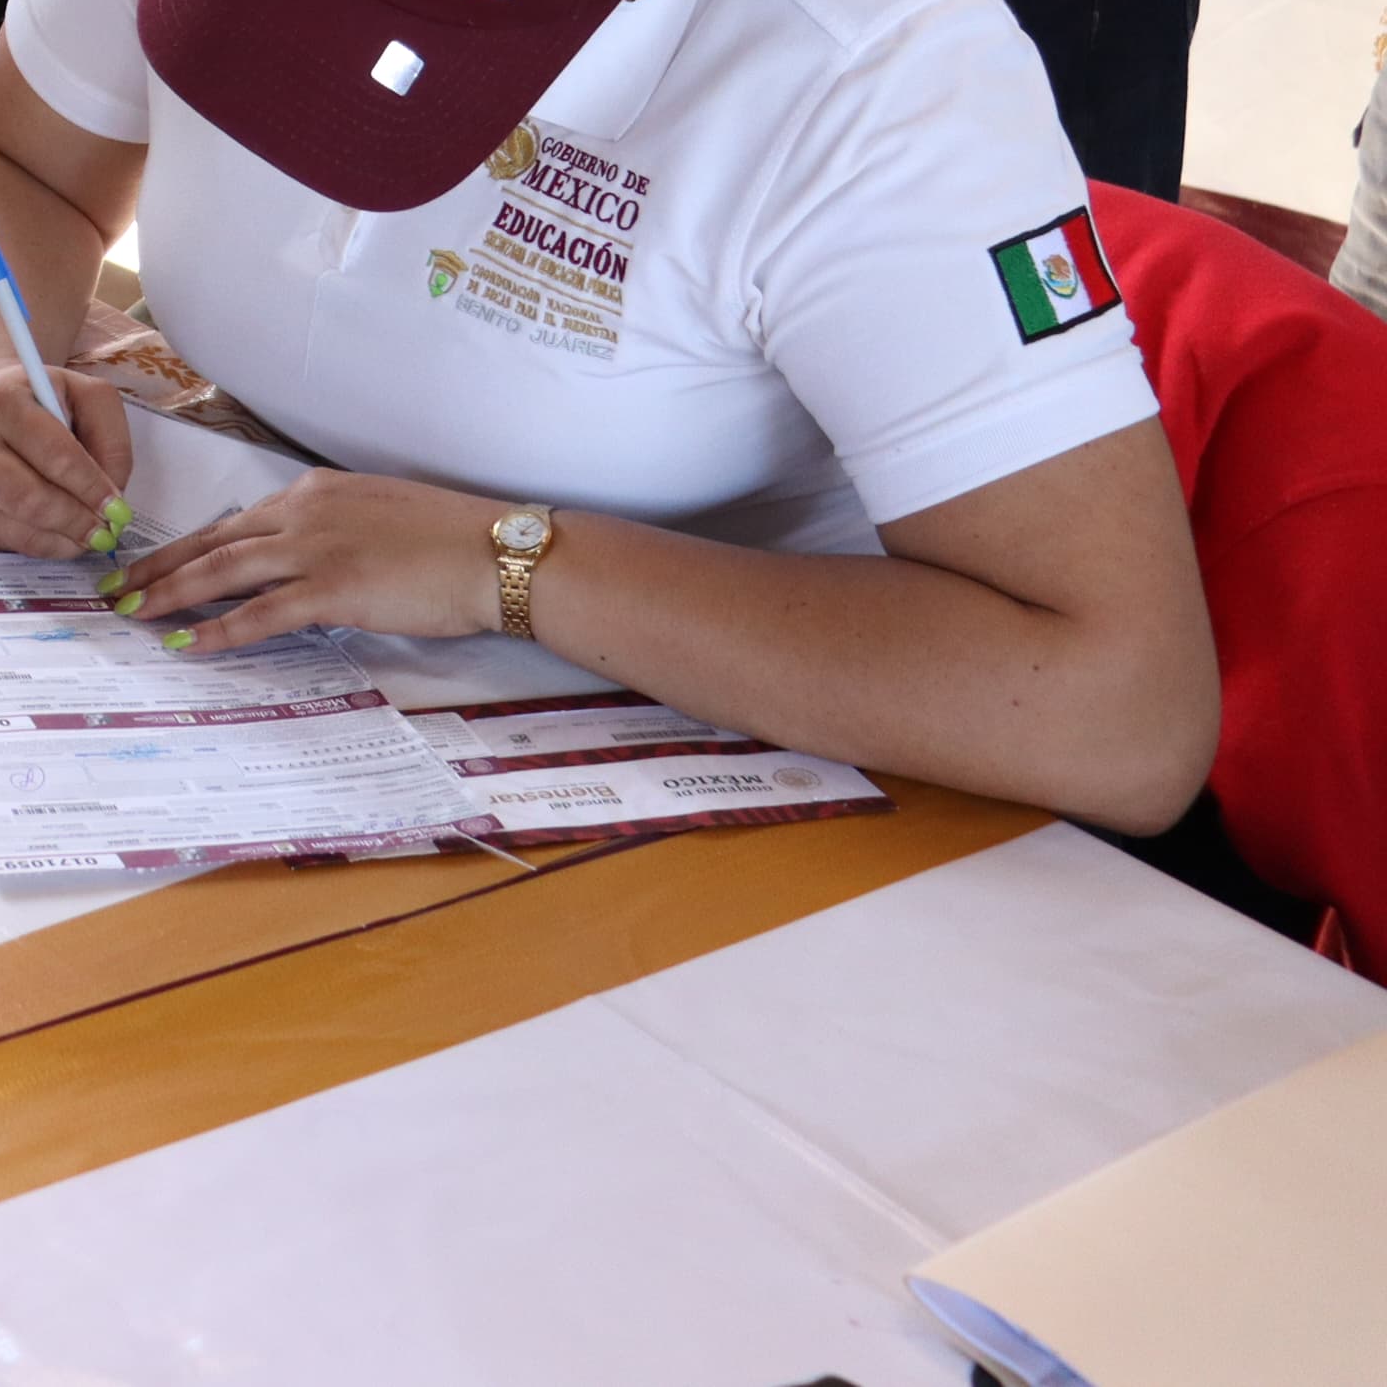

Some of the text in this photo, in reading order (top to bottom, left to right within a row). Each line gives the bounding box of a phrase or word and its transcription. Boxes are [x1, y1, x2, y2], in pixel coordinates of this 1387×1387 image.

[540, 135, 651, 197] GOBIERNO DE
[521, 159, 641, 232] MÉXICO
[492, 201, 629, 284] EDUCACIÓN
[455, 293, 522, 334] BENITO
[488, 785, 616, 806] Bienestar
[662, 774, 764, 791] MÉXICO
